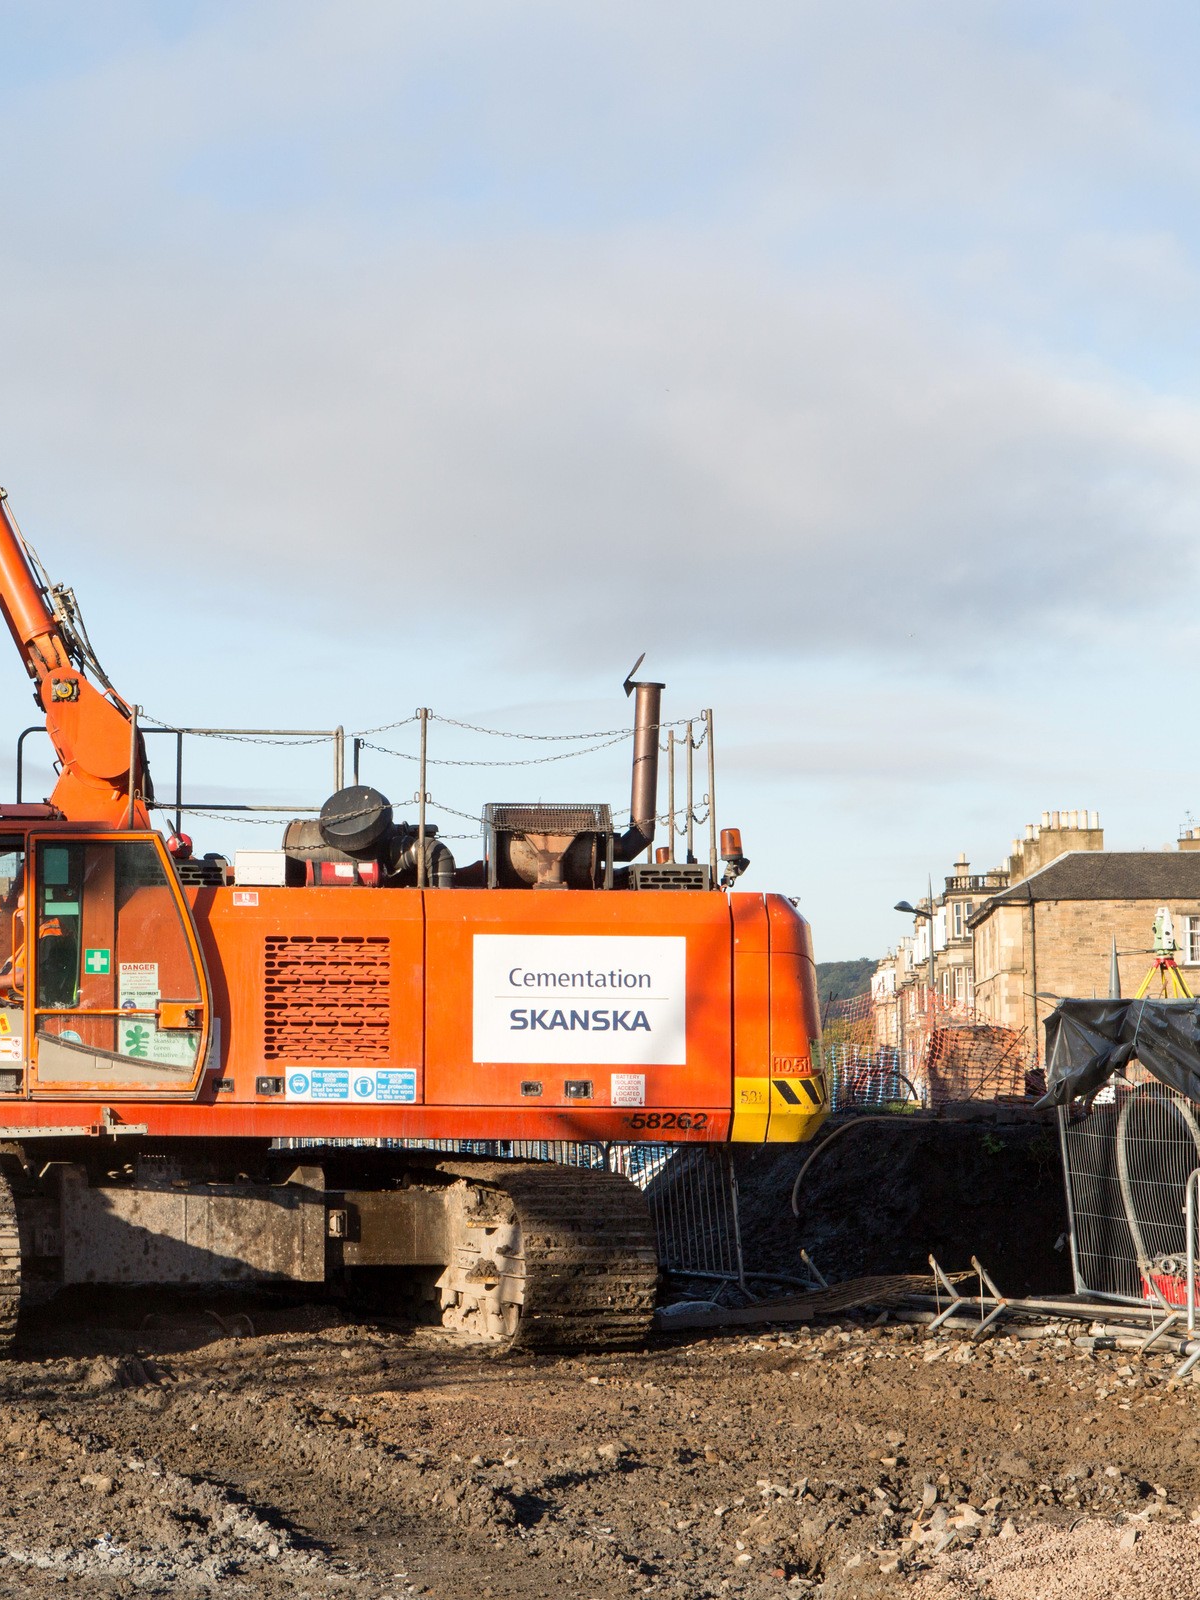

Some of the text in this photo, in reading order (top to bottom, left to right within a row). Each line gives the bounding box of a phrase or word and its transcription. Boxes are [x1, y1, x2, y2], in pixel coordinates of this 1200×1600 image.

[509, 967, 651, 988] Cementation
[510, 1009, 652, 1032] SKANSKA
[631, 1112, 708, 1130] 58262
